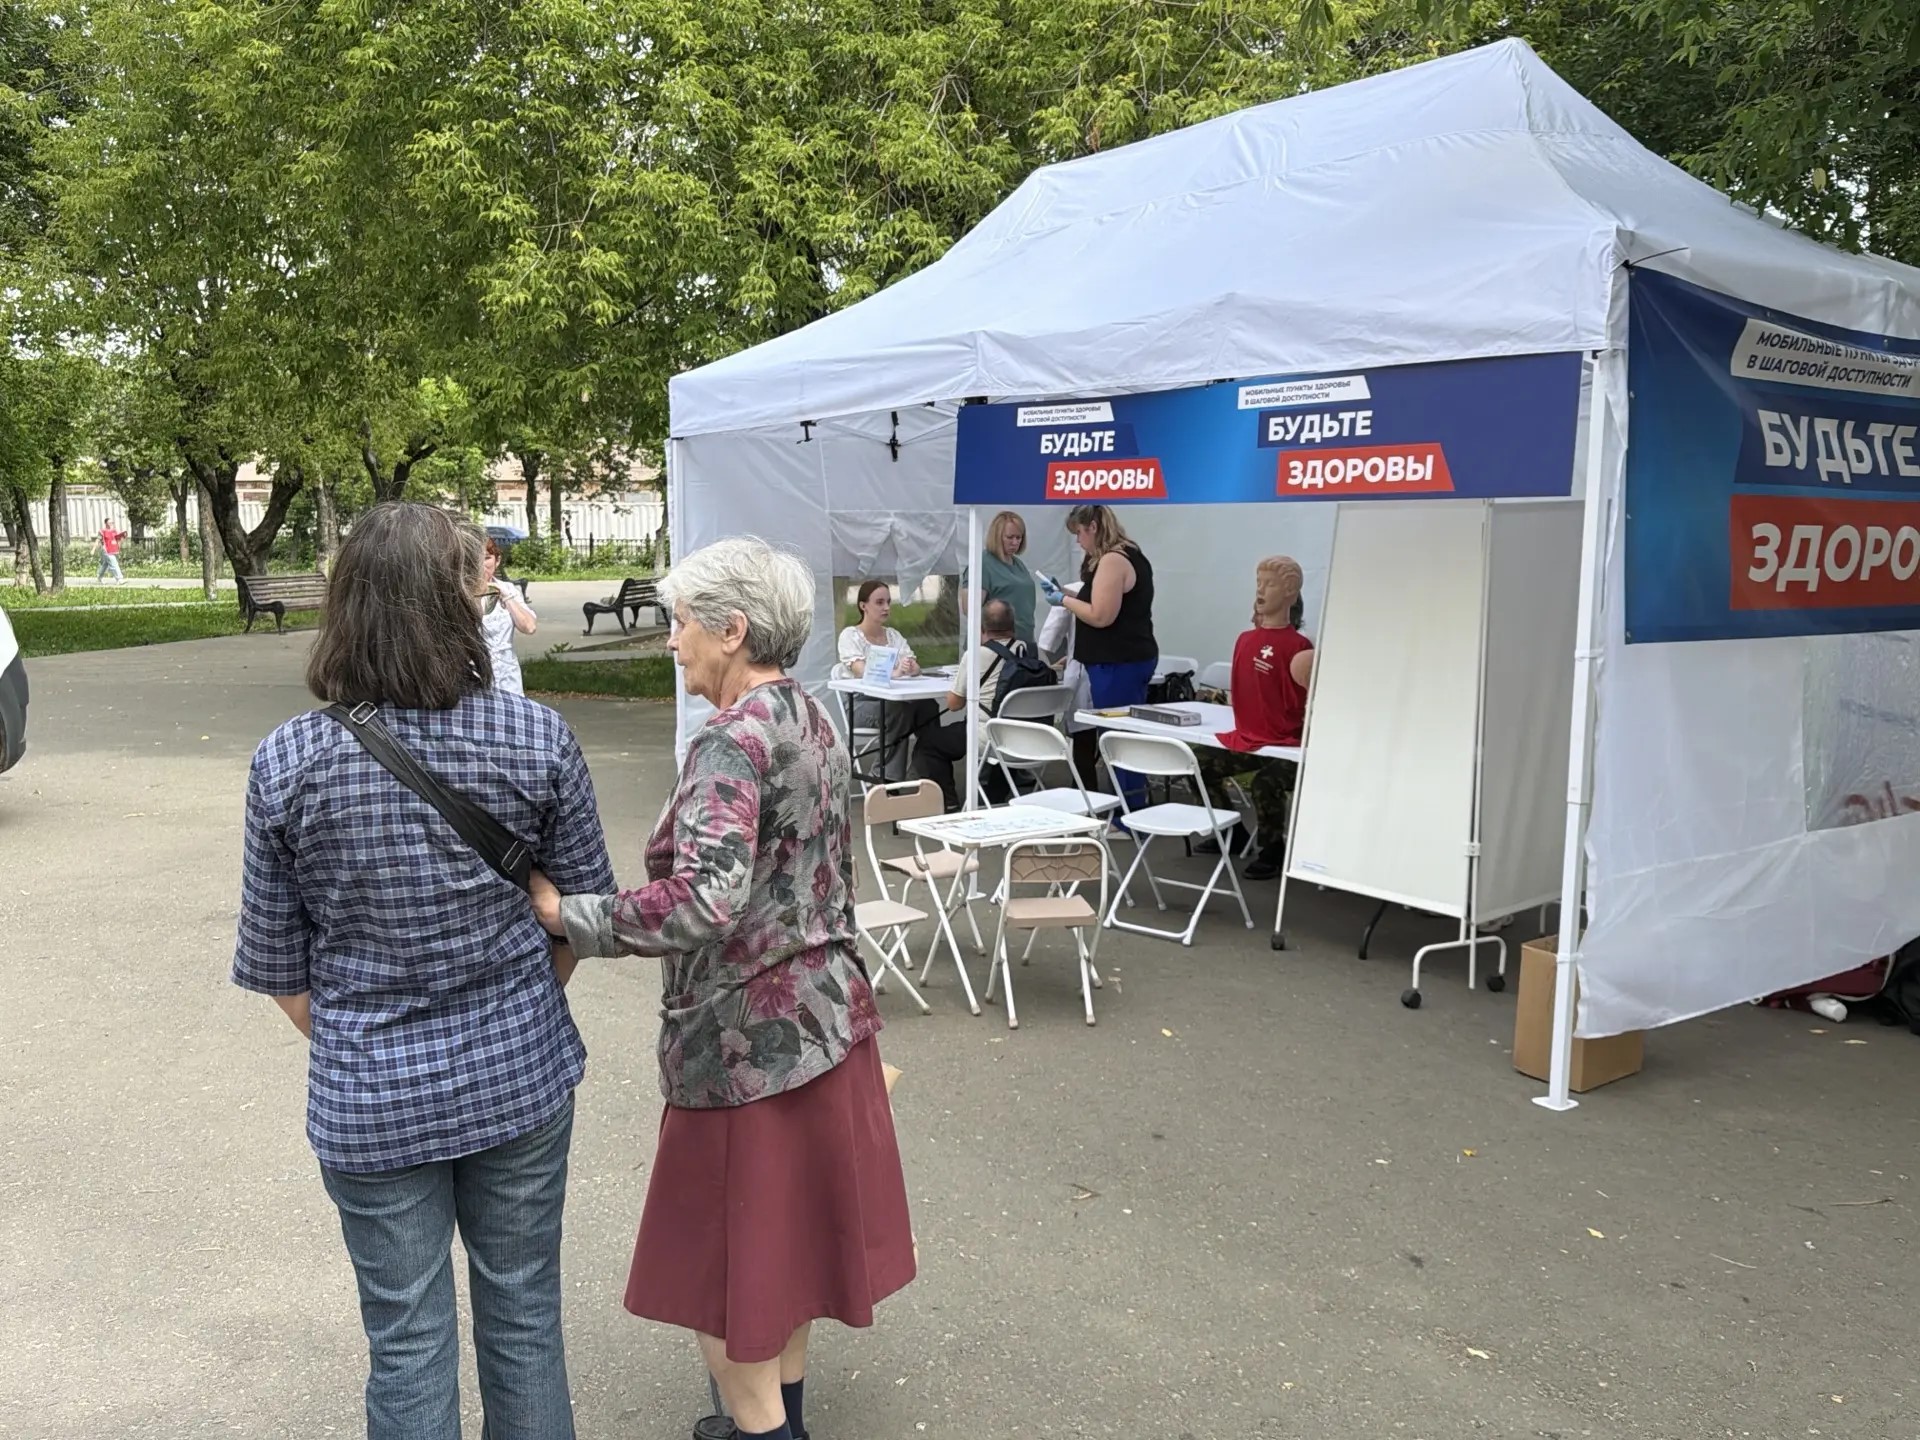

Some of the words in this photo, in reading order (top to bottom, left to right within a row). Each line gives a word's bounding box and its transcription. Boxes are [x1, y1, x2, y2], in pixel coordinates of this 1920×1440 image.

[1756, 331, 1842, 358] МОБИЛЬНЫЕ
[1747, 354, 1758, 368] В
[1758, 355, 1827, 379] ШАГОВОЙ
[1826, 366, 1912, 389] ДОСТУПНОСТИ
[1245, 387, 1285, 396] МОБИЛЬНЫЕ
[1286, 384, 1313, 392] ПУНКТЫ
[1250, 396, 1280, 405] ШАГОВОЙ
[1281, 392, 1330, 402] ДОСТУПНОСТИ
[1268, 410, 1373, 443] БУДЬТЕ
[1040, 430, 1115, 456] БУДЬТЕ
[1757, 409, 1920, 484] БУДЬТЕ
[1053, 468, 1154, 494] ЗДОРОВЫ
[1287, 455, 1434, 489] ЗДОРОВЫ
[1748, 522, 1920, 592] ЗДОРО
